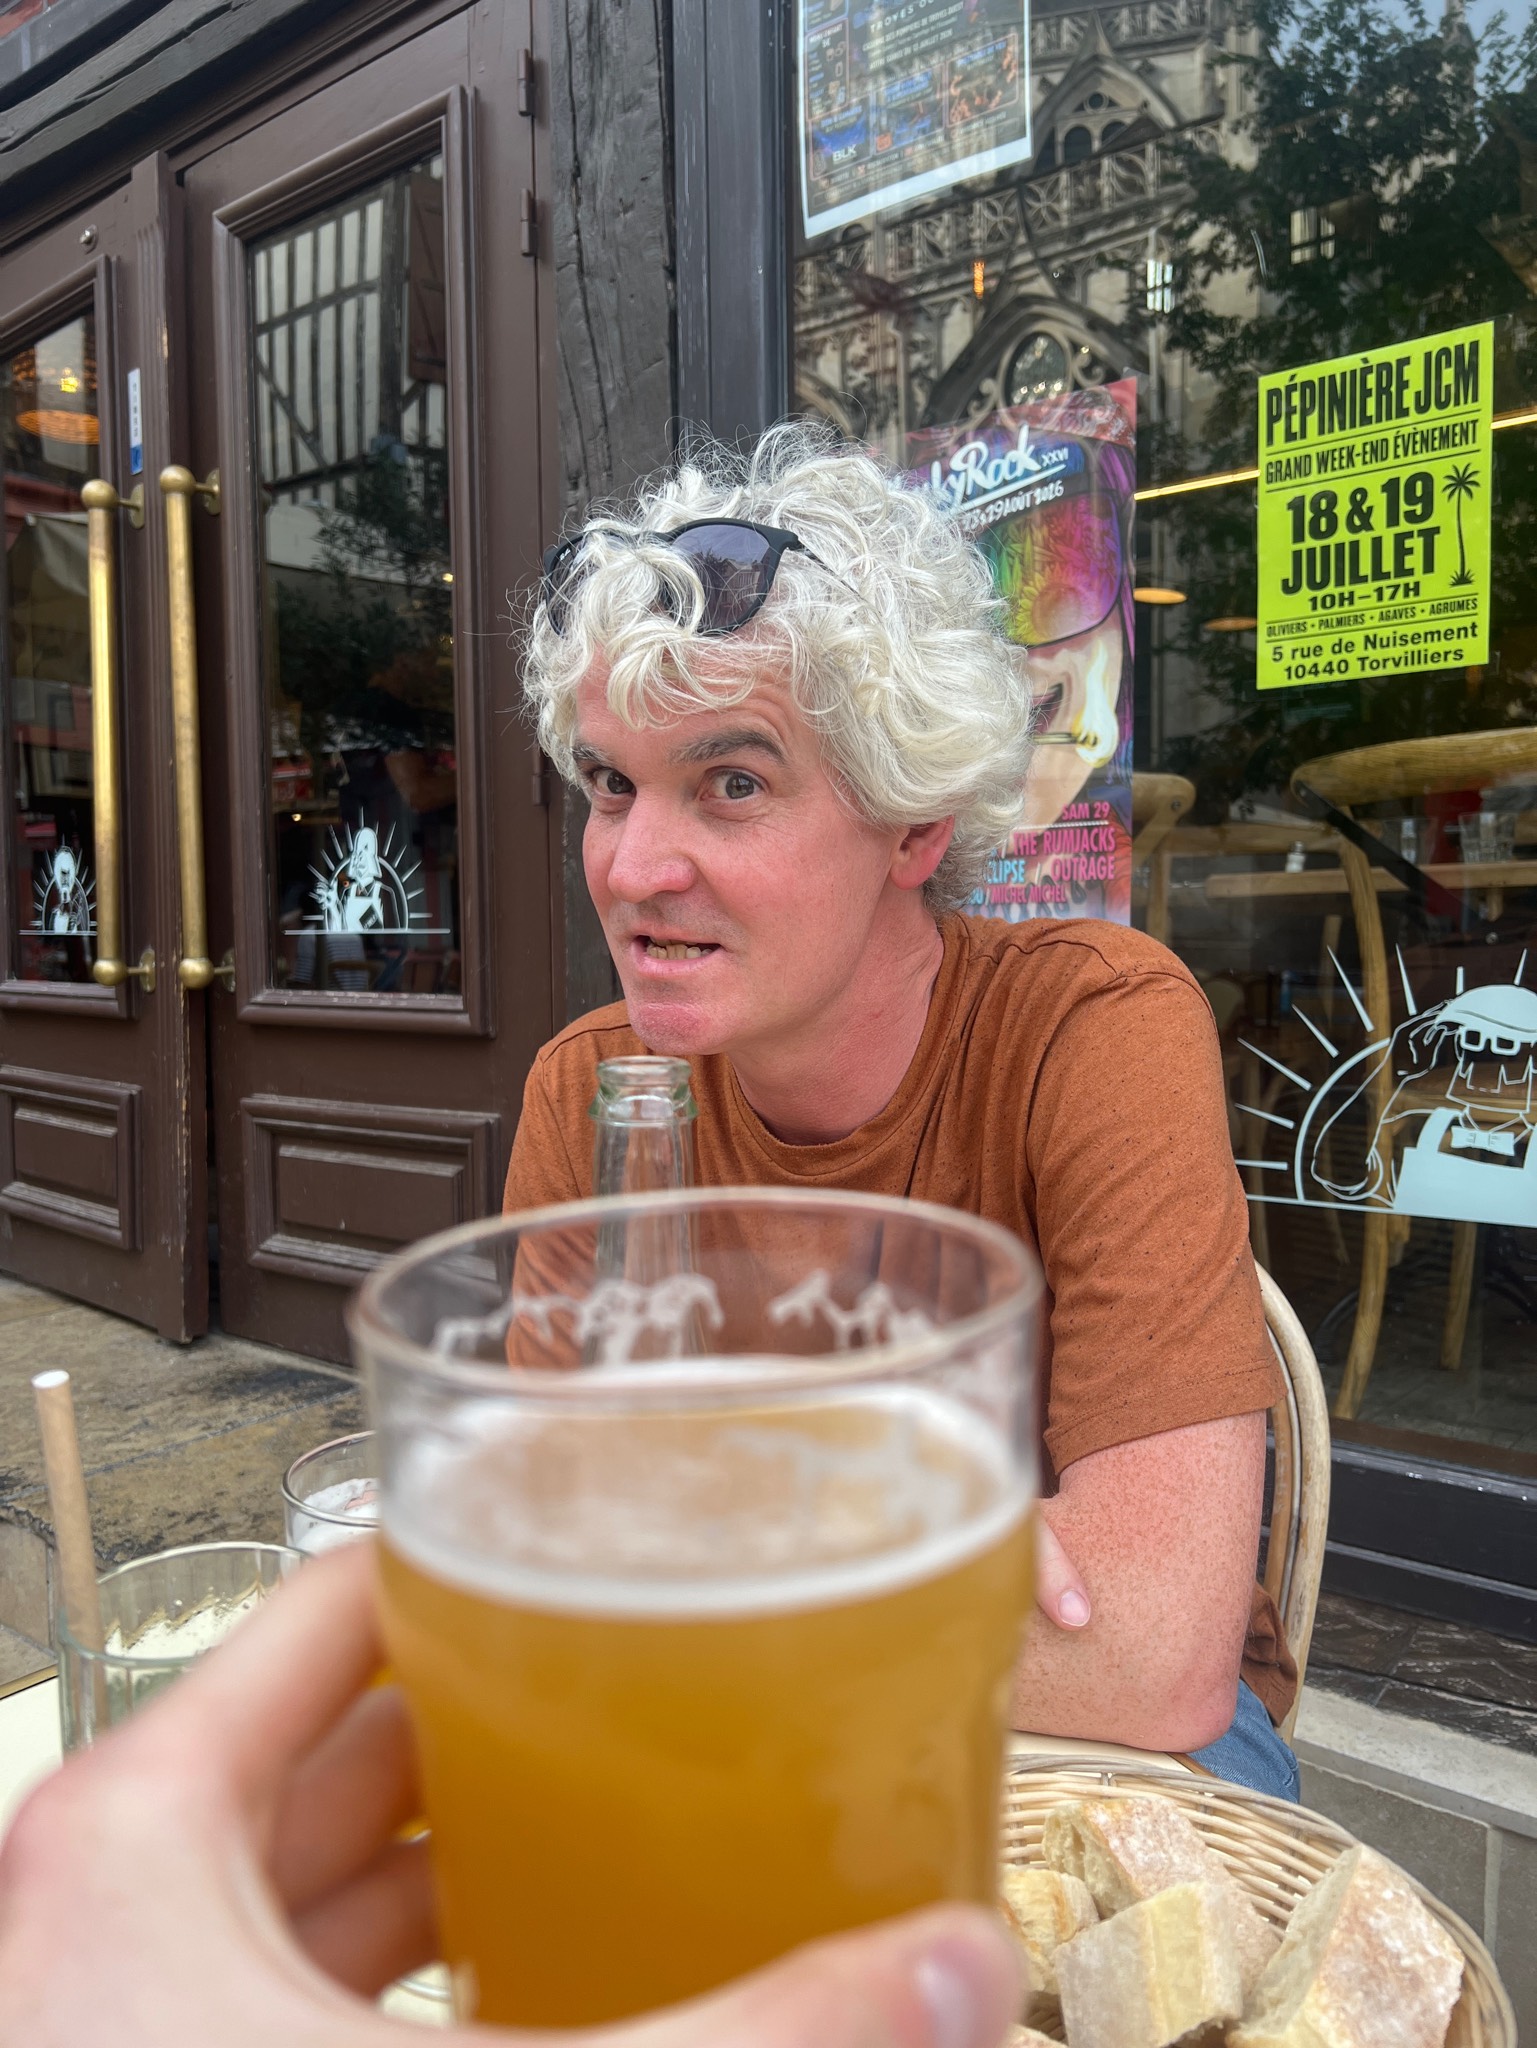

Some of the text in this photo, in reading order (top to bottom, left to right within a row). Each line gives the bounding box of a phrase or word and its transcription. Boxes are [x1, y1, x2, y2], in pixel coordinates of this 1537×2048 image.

[870, 5, 914, 33] TROYES
[1266, 340, 1480, 447] PÉPINIÈRE JCM
[1266, 418, 1479, 485] GRAND WEEK-END ÉVÈNEMENT
[1003, 490, 1034, 517] AOÛT
[1033, 479, 1065, 505] 2026
[1287, 471, 1434, 545] 18 & 19
[1281, 526, 1441, 596] JUILLET
[1266, 598, 1478, 638] OLIVIERS PALMIERS AGAVES AGRUMES
[1272, 622, 1479, 662] 5 rue de Nuisement
[1284, 648, 1464, 681] 10440 Torvilliers
[1062, 801, 1111, 820] SAM 29
[1013, 827, 1116, 856] THE RUMJACKS
[1051, 856, 1116, 882] OUTRAGE
[991, 884, 1027, 904] MICHEL
[1029, 884, 1067, 904] MICHEL
